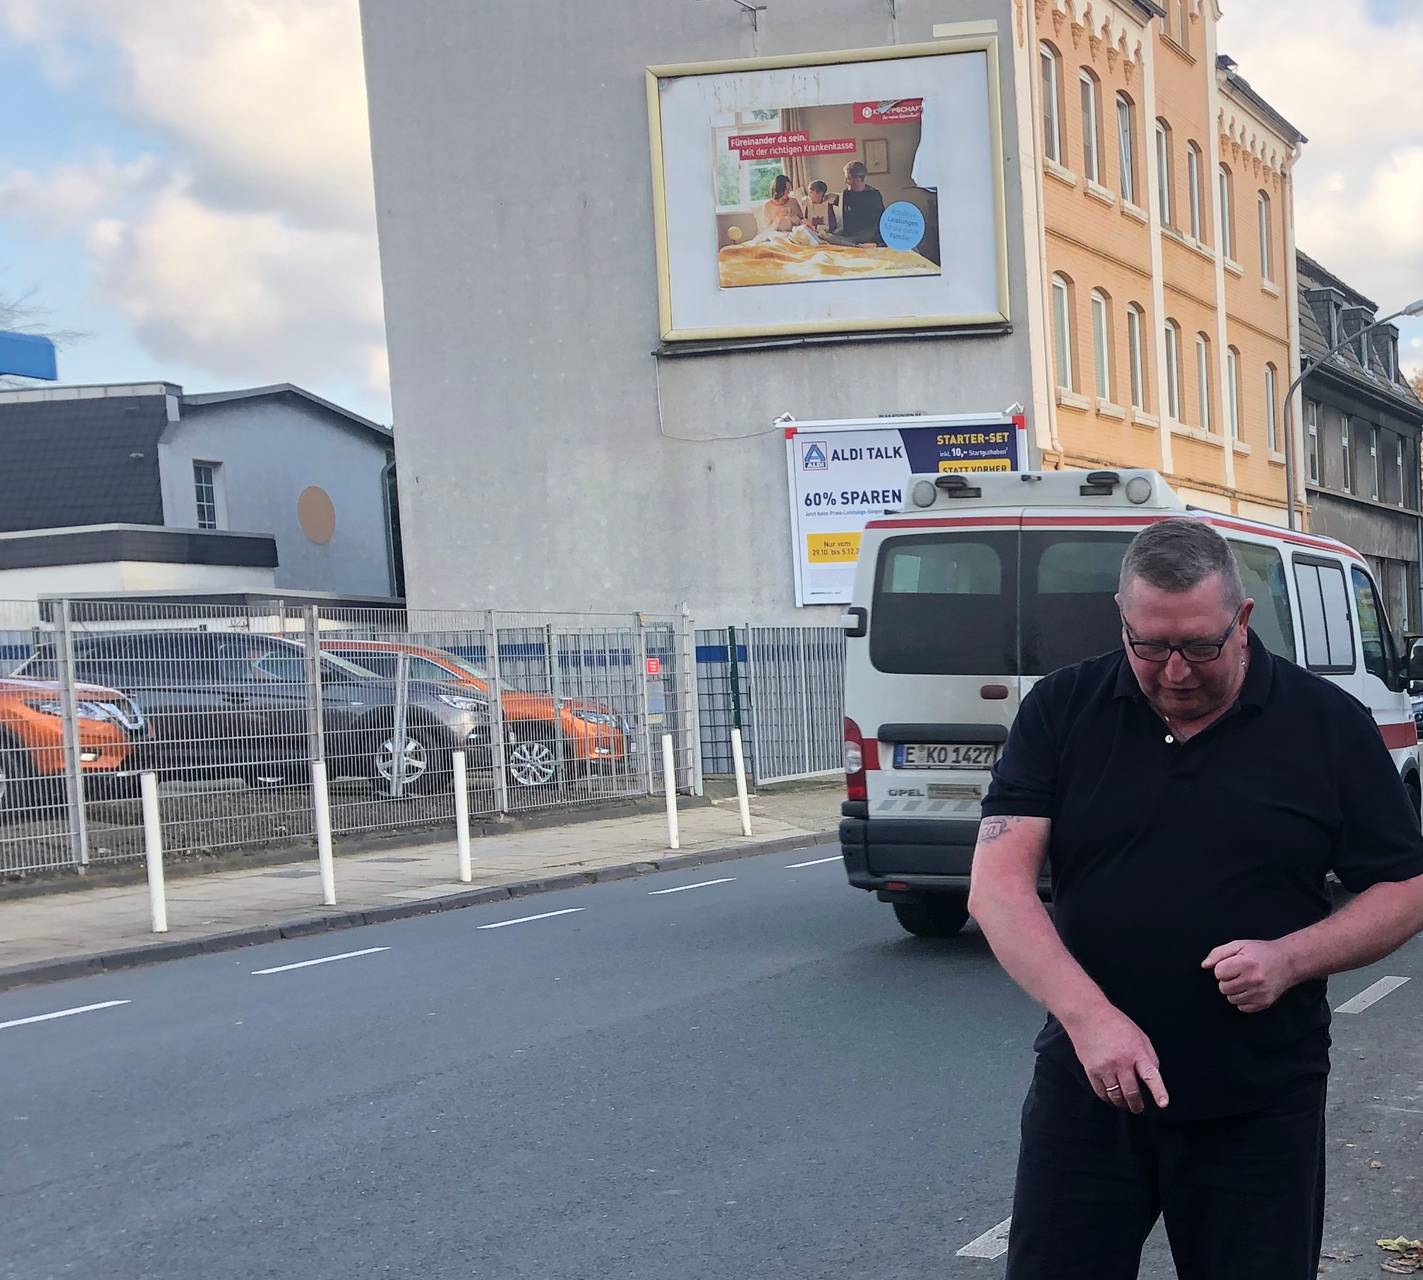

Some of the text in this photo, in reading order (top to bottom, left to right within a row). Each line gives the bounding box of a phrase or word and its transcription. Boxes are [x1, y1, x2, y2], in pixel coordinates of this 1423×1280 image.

[731, 133, 807, 148] Füreinander da sein.
[741, 141, 854, 157] Mit der richtigen Krankenkasse
[936, 432, 1009, 445] STARTER-SET
[831, 446, 903, 462] ALDI TALK
[804, 489, 903, 507] 60% SPAREN
[905, 747, 915, 763] E
[951, 746, 992, 764] 1427
[888, 789, 925, 797] OPEL
